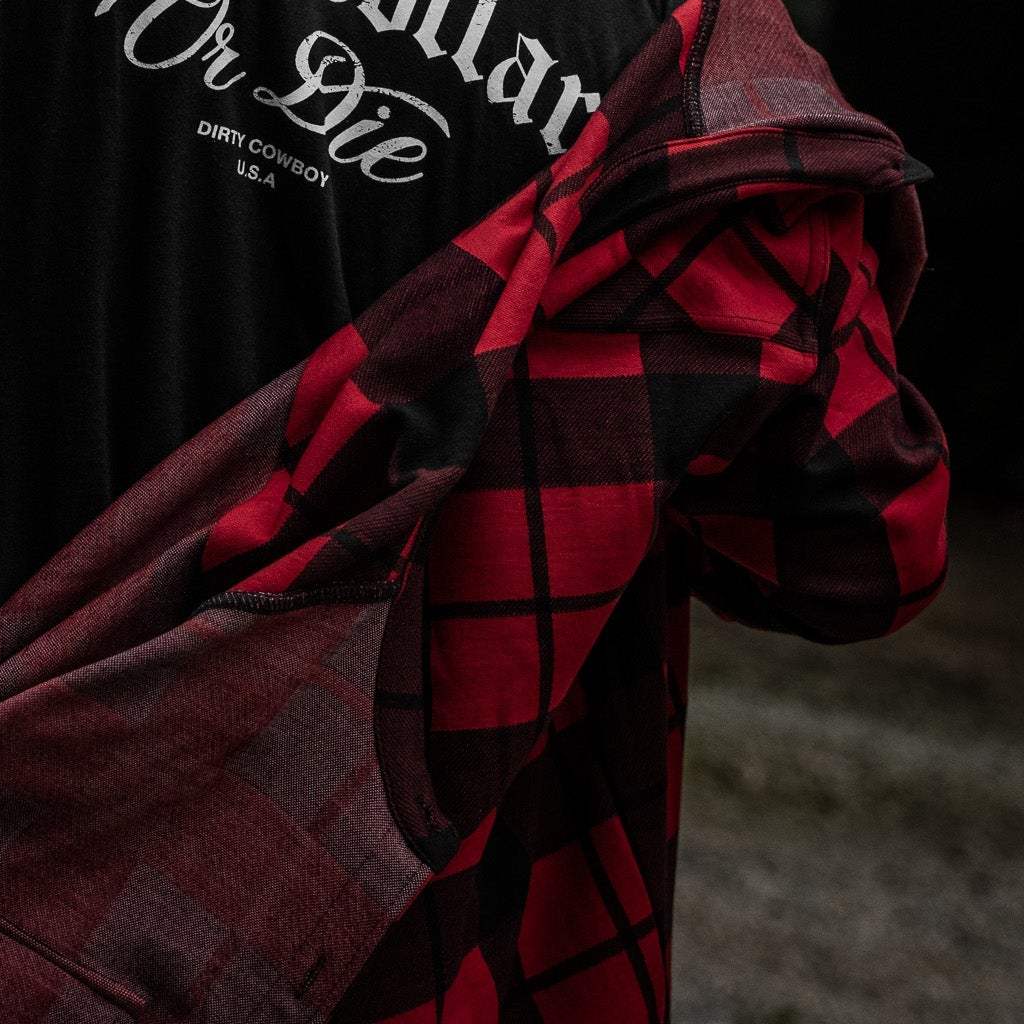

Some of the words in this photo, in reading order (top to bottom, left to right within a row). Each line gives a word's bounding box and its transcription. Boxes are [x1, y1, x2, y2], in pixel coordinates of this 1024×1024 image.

[253, 30, 451, 183] Die
[197, 120, 246, 148] DIRTY
[248, 138, 329, 188] COWBOY
[237, 159, 275, 189] U.S.A
